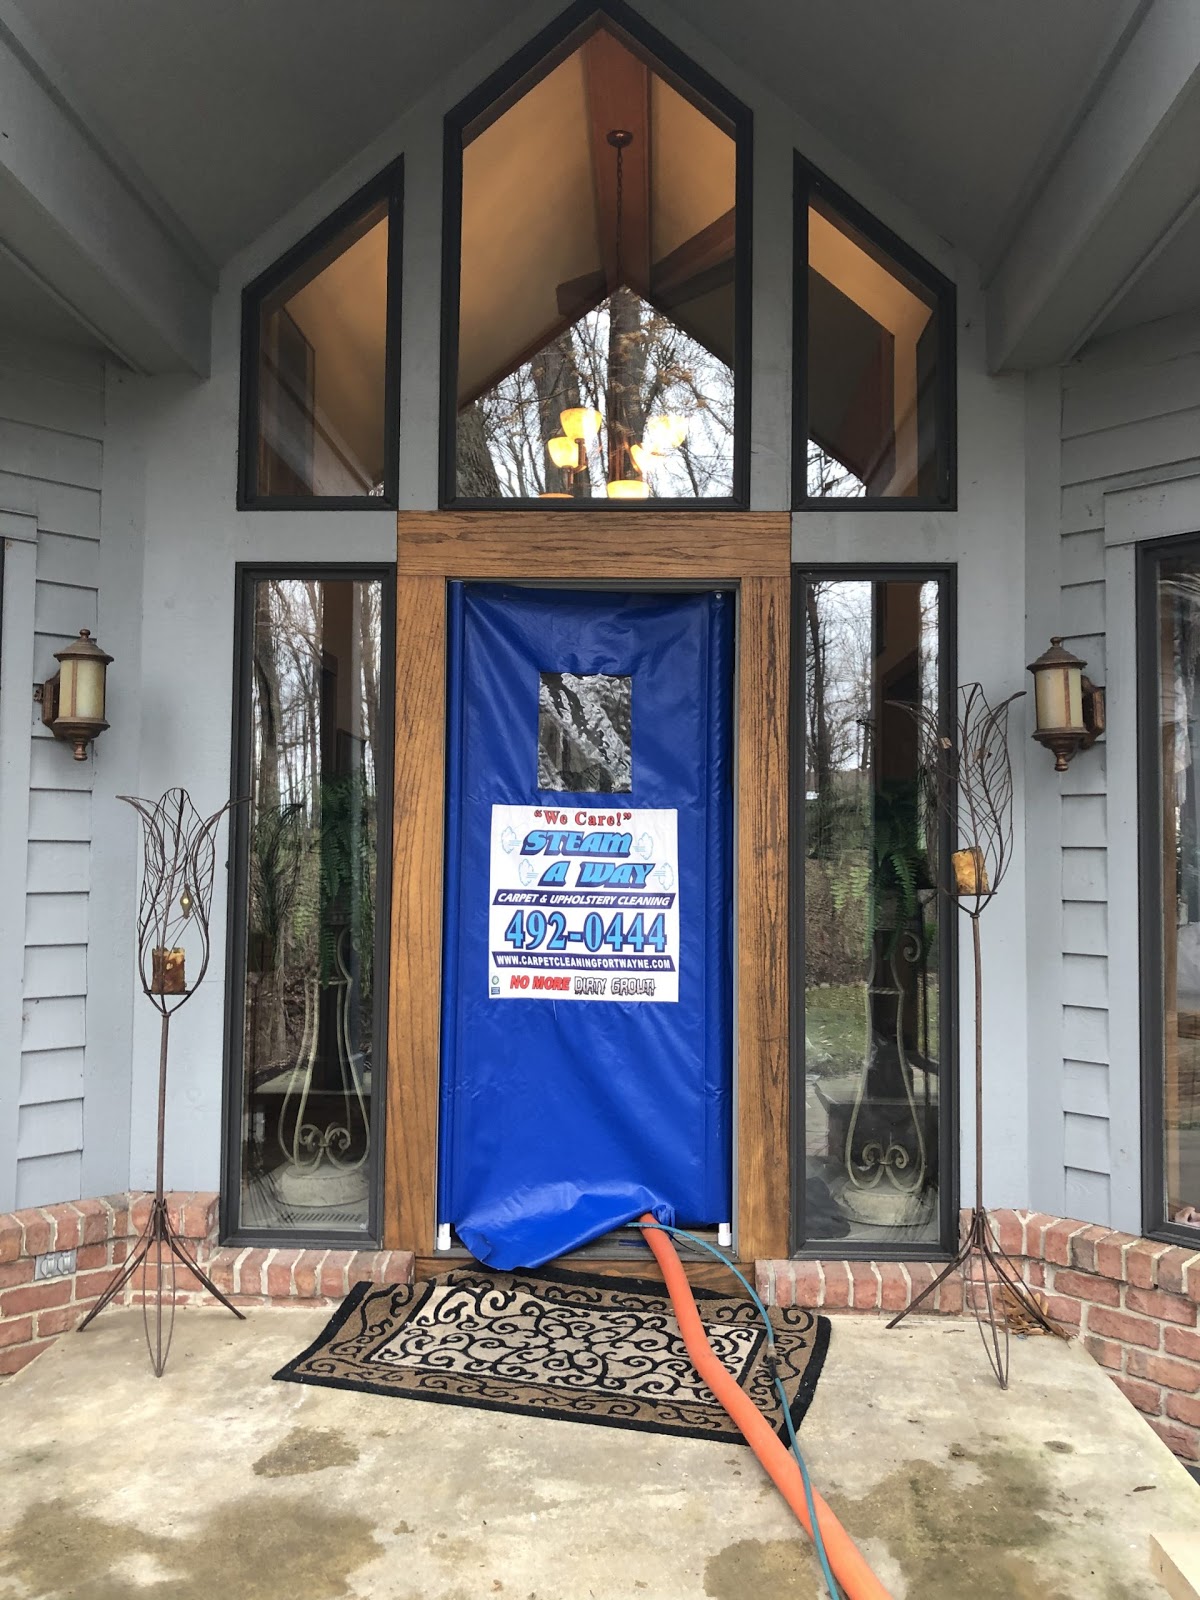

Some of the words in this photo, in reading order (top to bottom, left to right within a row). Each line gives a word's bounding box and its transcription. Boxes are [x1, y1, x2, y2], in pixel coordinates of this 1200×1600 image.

[575, 862, 656, 888] WAY
[498, 893, 538, 902] CARPET
[540, 895, 547, 903] &
[550, 894, 616, 905] UPHOLSTERY
[618, 896, 670, 906] CLEANING
[505, 910, 667, 952] 492-0444
[497, 955, 671, 969] WWW.CARPETCLEANINGFORTWAYNE.COM
[510, 975, 529, 989] NO
[532, 976, 571, 990] MORE
[574, 976, 606, 995] DIRTY
[611, 978, 656, 996] GROUT!
